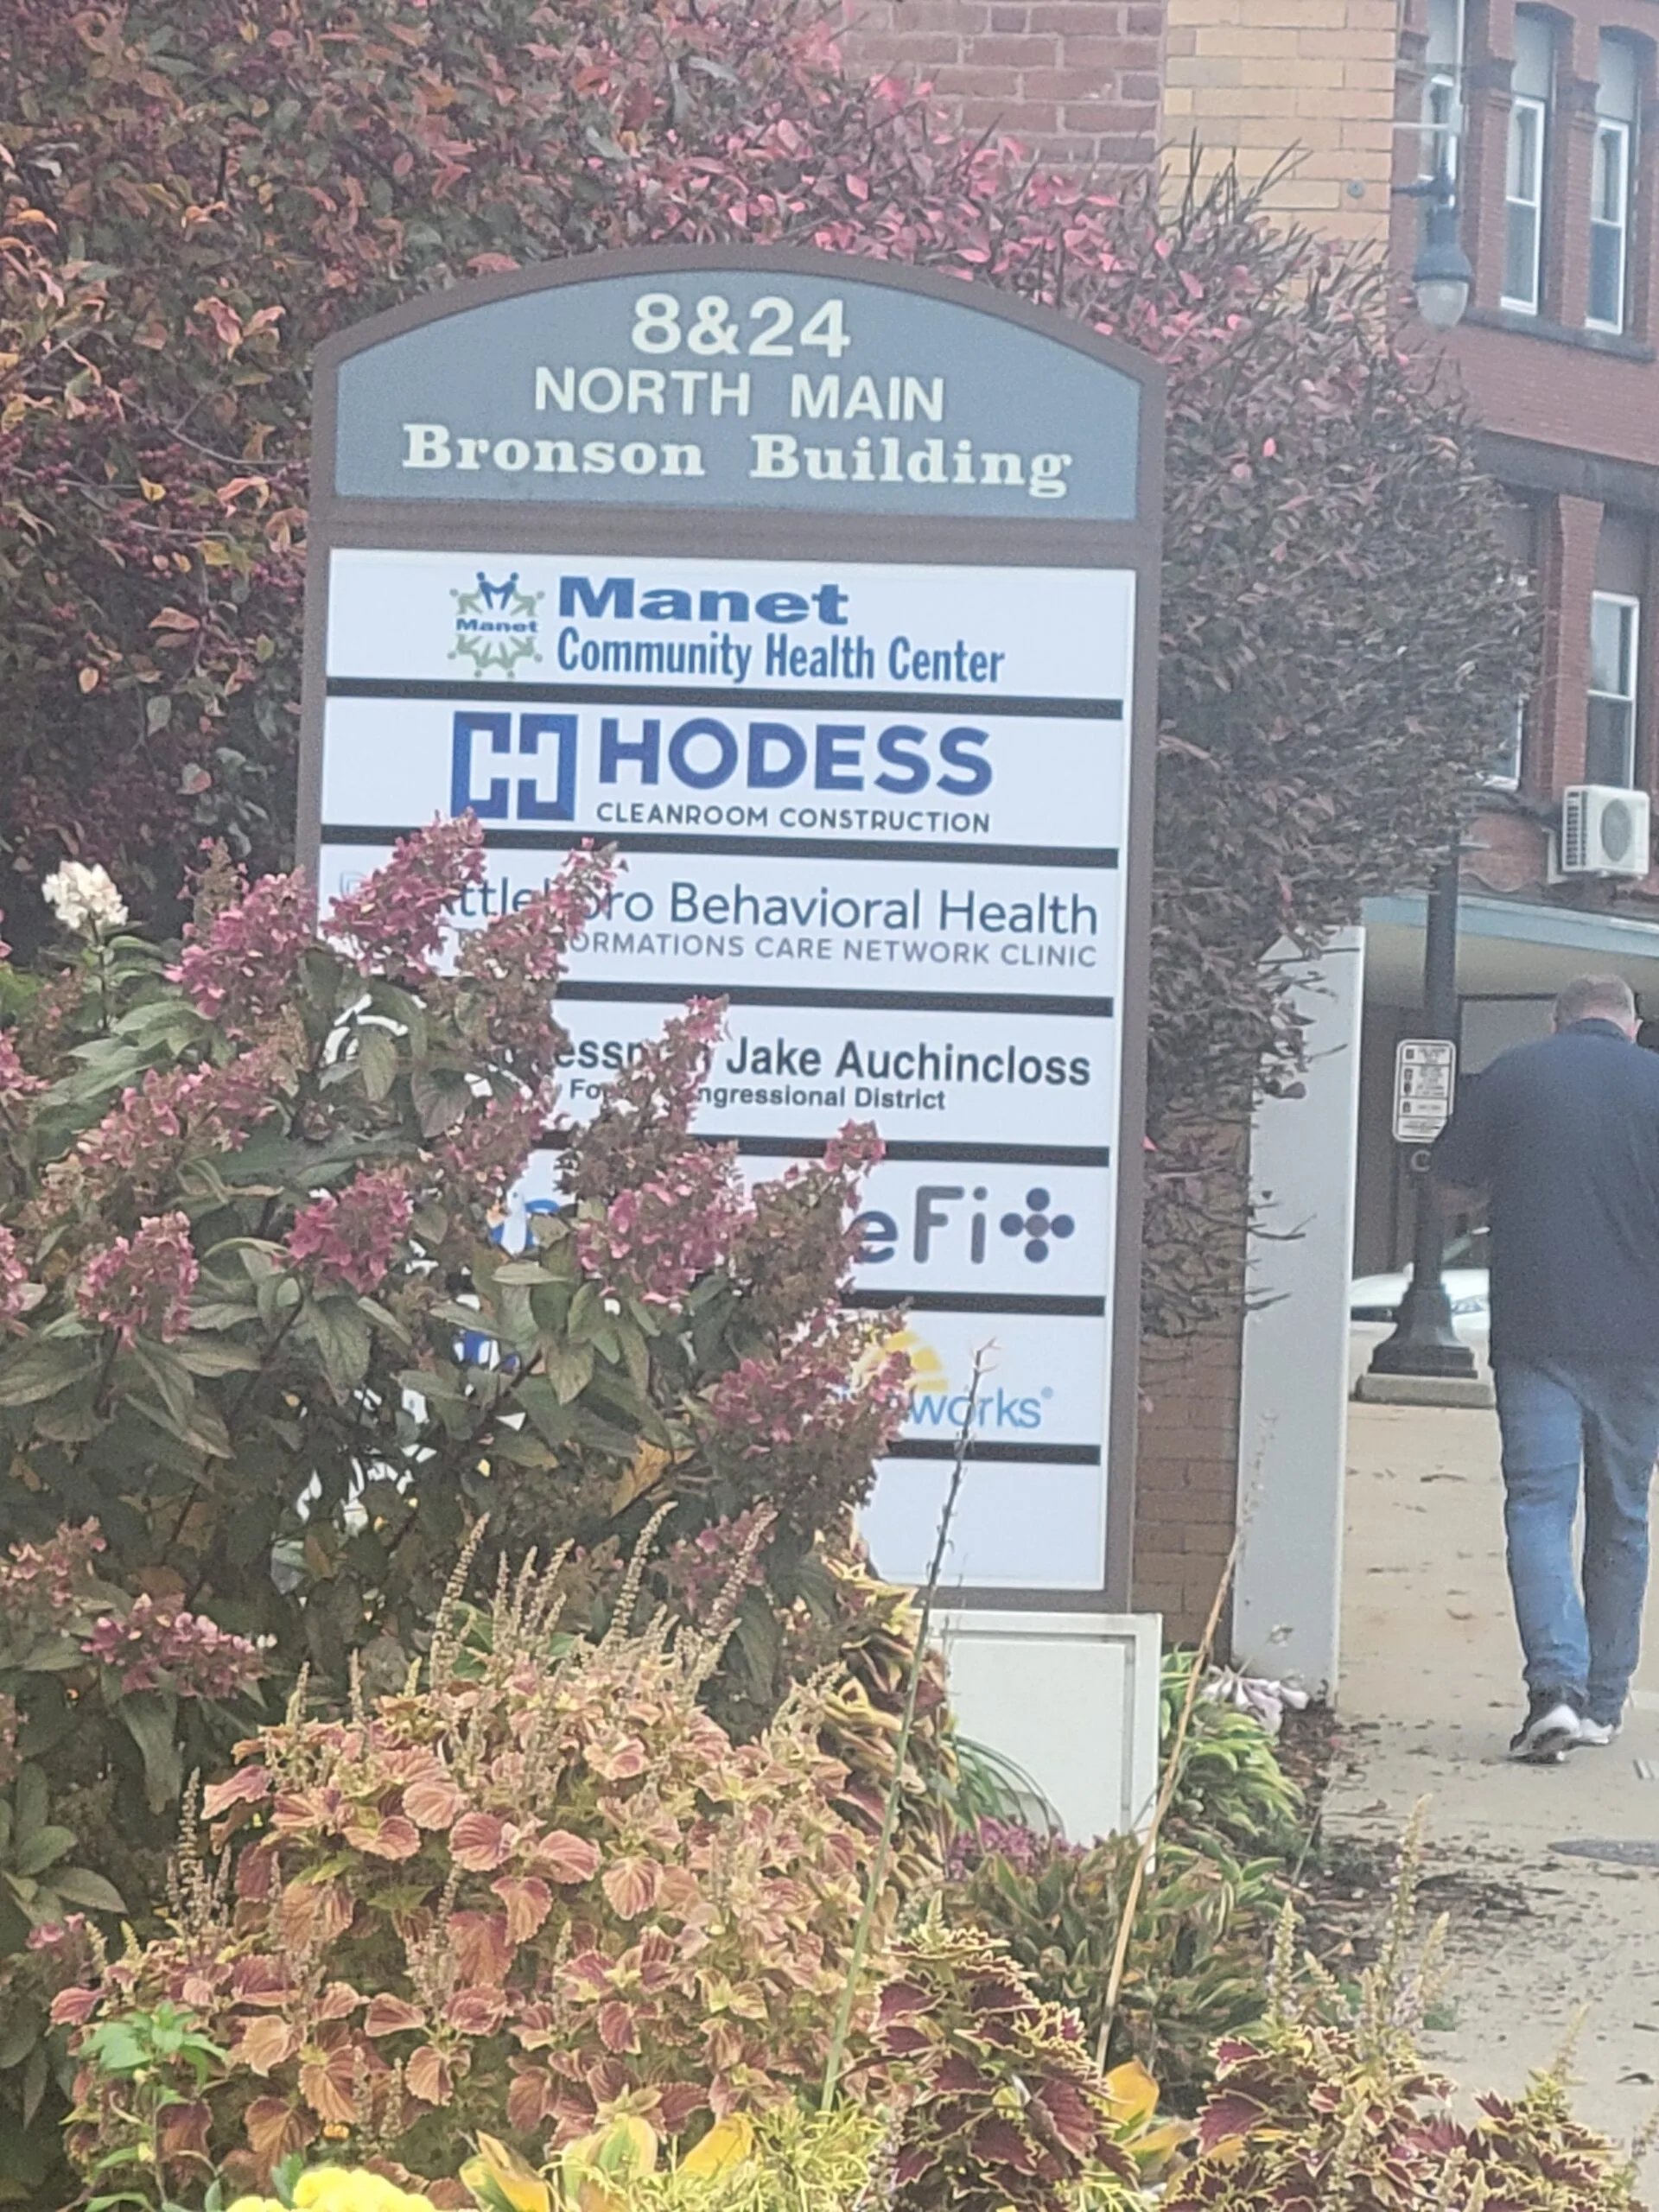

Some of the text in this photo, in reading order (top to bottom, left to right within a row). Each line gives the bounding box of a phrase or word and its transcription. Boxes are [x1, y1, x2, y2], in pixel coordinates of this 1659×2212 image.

[632, 293, 851, 358] 8&24
[535, 366, 944, 422] NORTH MAIN
[402, 423, 1073, 499] Bronson Building
[456, 618, 537, 633] Manet
[559, 575, 849, 626] Manet
[557, 626, 1006, 684] Community Health Center
[598, 716, 995, 797] HODESS
[596, 802, 990, 835] CLEANROOM CONSTRUCTION
[671, 880, 921, 931] Behavioral
[939, 888, 1097, 937] Health
[754, 936, 832, 960] CARE
[843, 939, 990, 965] NETWORK
[1001, 944, 1097, 969] CLINIC
[726, 1037, 822, 1077] Jake
[835, 1040, 1091, 1087] Auchincloss
[696, 1084, 946, 1111] ngressional District
[910, 1386, 1042, 1430] works
